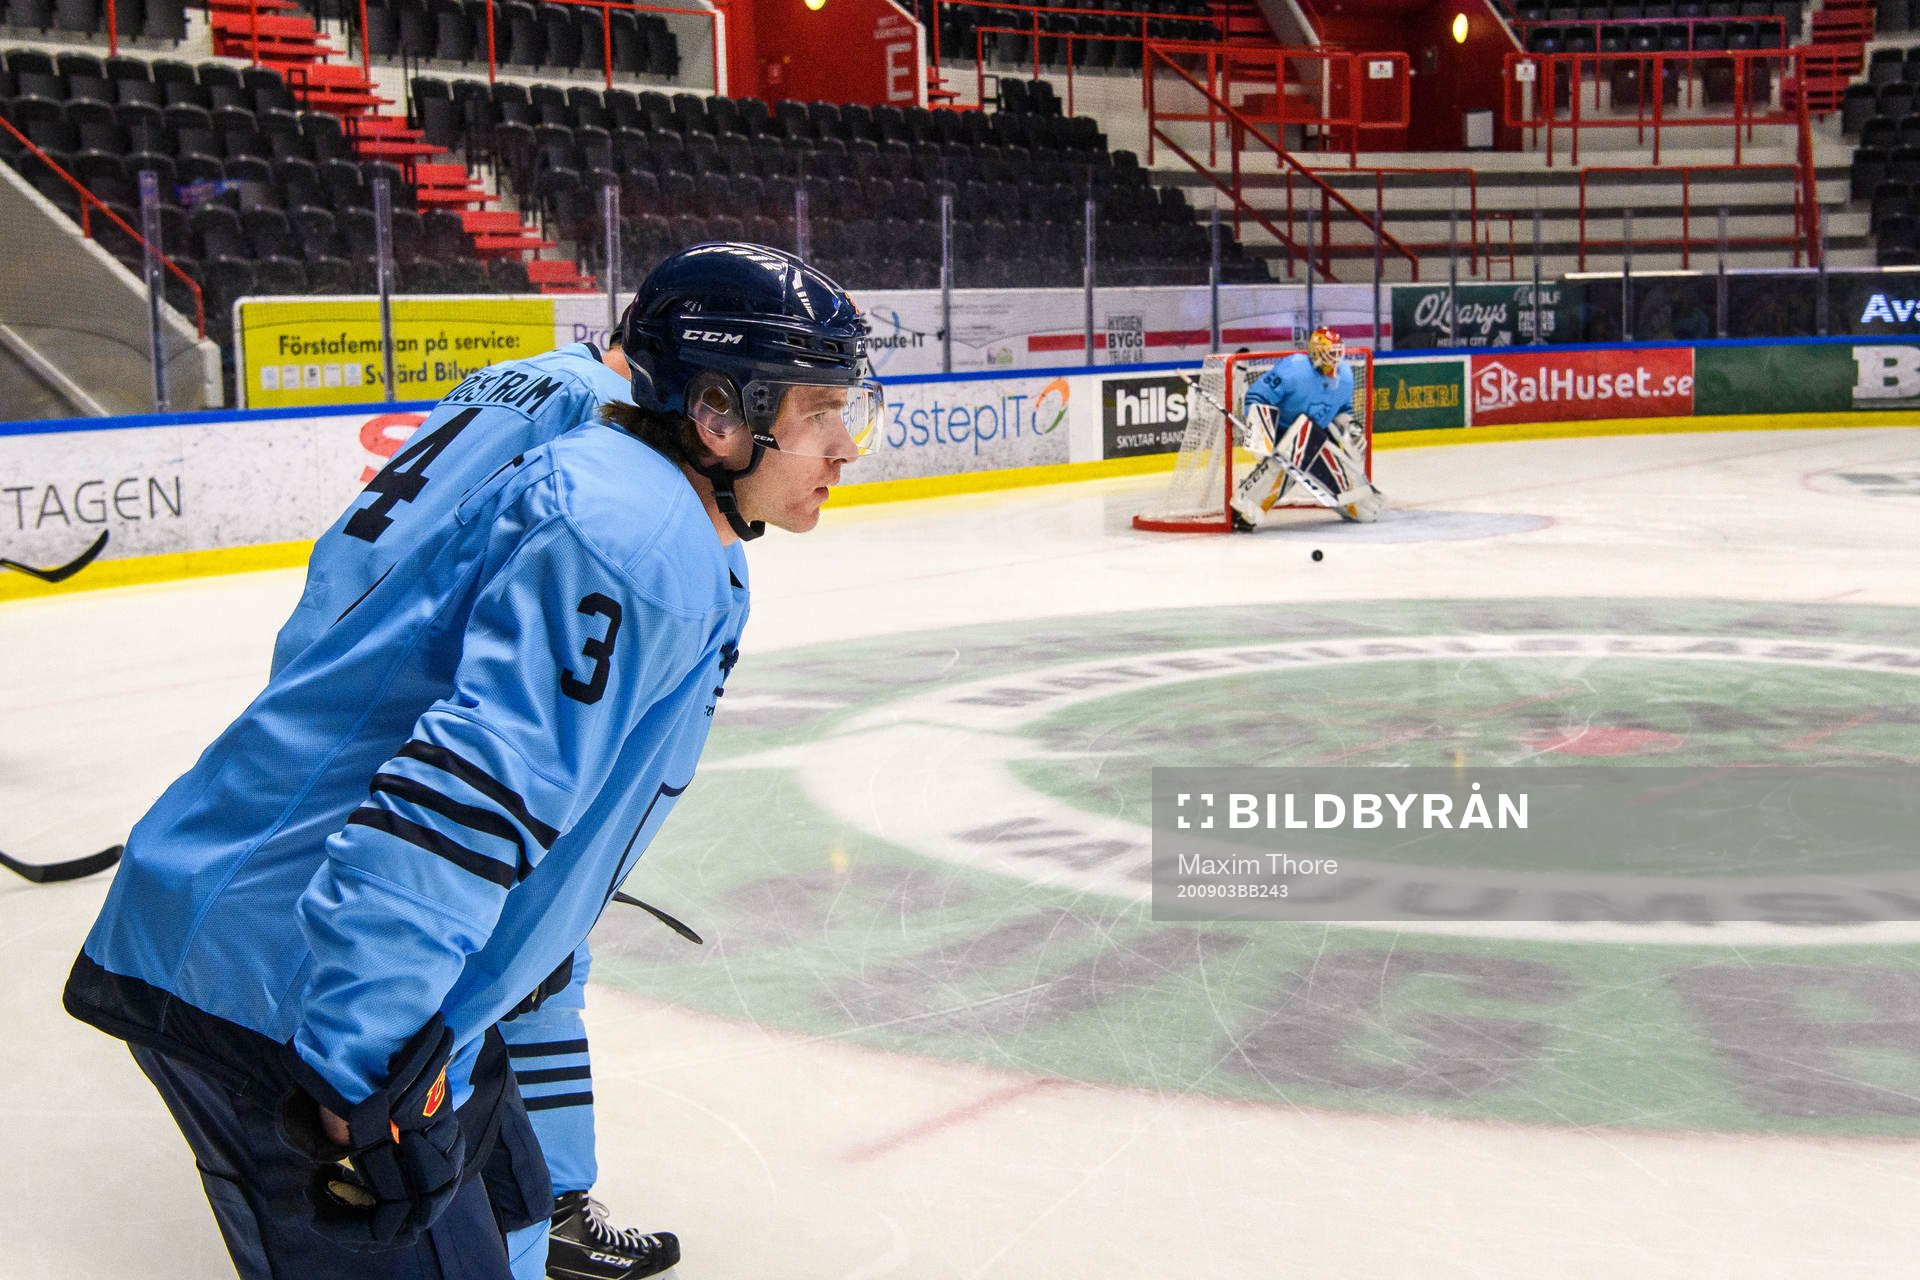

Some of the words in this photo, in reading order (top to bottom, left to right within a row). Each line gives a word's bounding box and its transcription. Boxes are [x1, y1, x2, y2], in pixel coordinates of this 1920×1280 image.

[886, 43, 914, 100] E
[279, 333, 417, 356] Förstafeman
[425, 331, 448, 355] på
[454, 331, 520, 350] service:
[682, 329, 744, 345] CCM
[1108, 332, 1143, 348] BYGG
[1480, 365, 1694, 404] SkalHuset.se
[887, 394, 1028, 456] 3stepIT
[1117, 432, 1155, 449] SKYLTAR
[3, 475, 183, 530] TAGEN
[560, 592, 622, 705] 3
[590, 1251, 634, 1268] CCM
